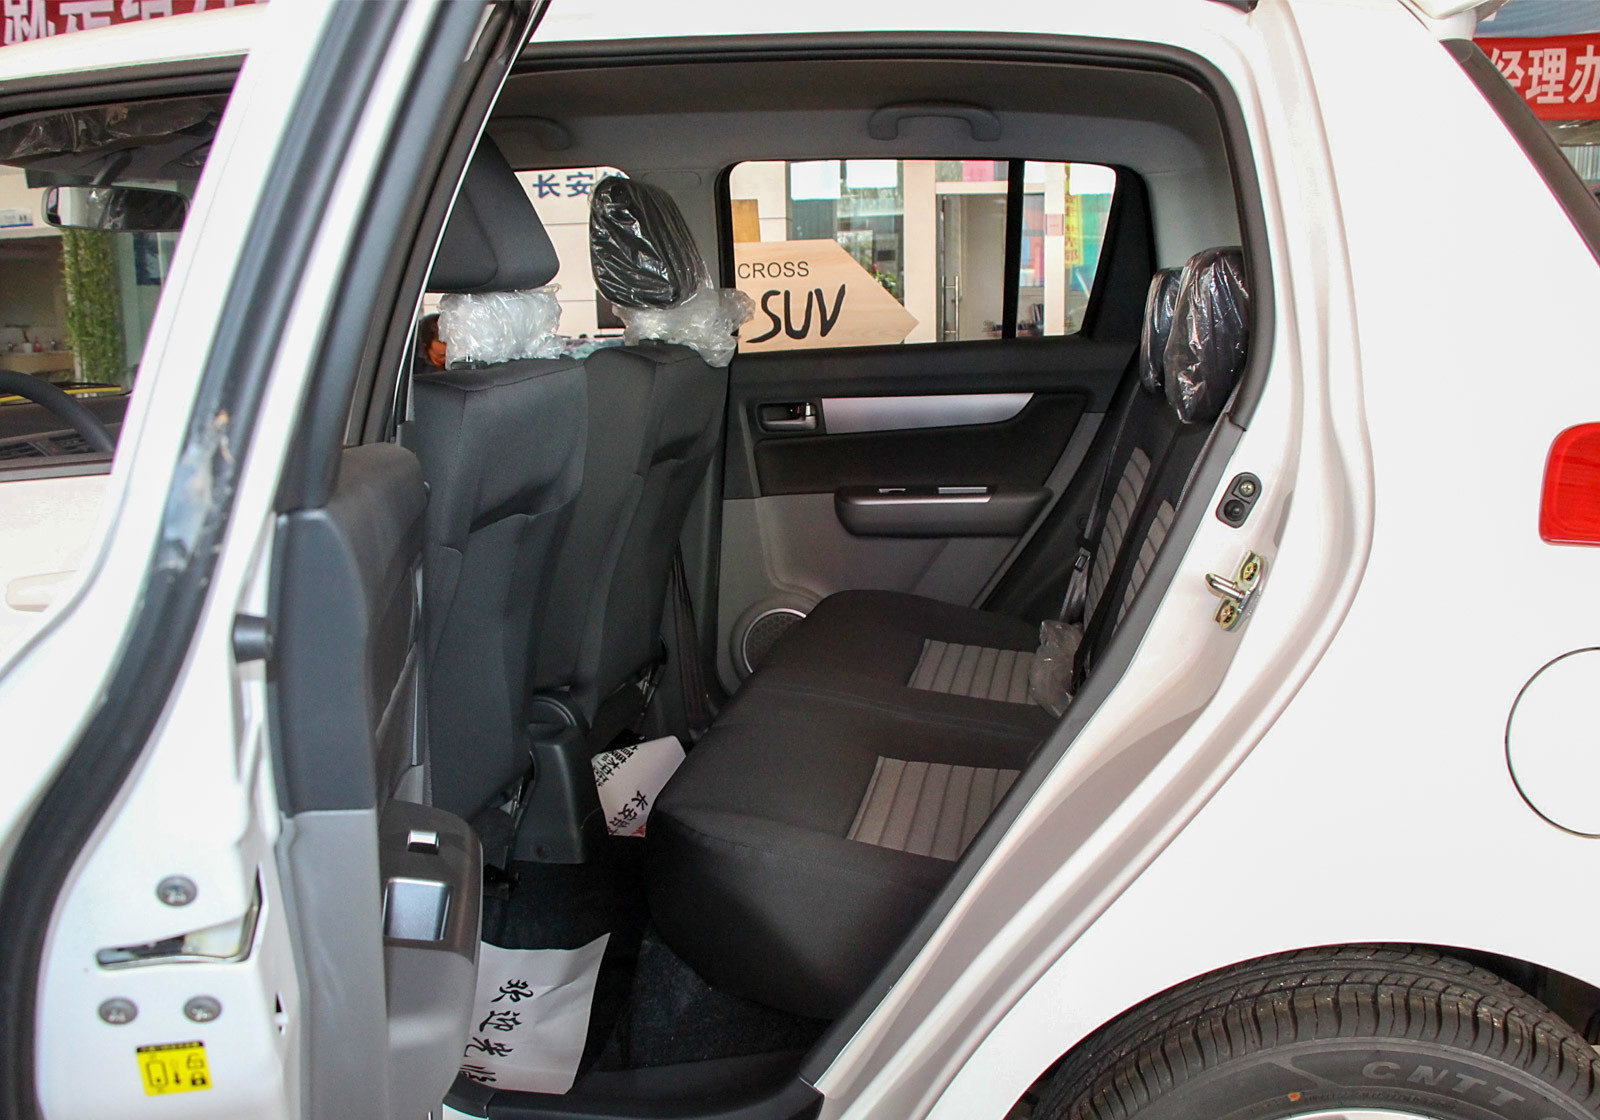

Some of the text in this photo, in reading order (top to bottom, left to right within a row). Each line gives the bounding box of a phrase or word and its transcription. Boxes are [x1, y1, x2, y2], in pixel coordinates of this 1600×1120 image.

[532, 171, 622, 198] 长安
[737, 261, 809, 279] CROSS
[745, 283, 846, 343] SUV
